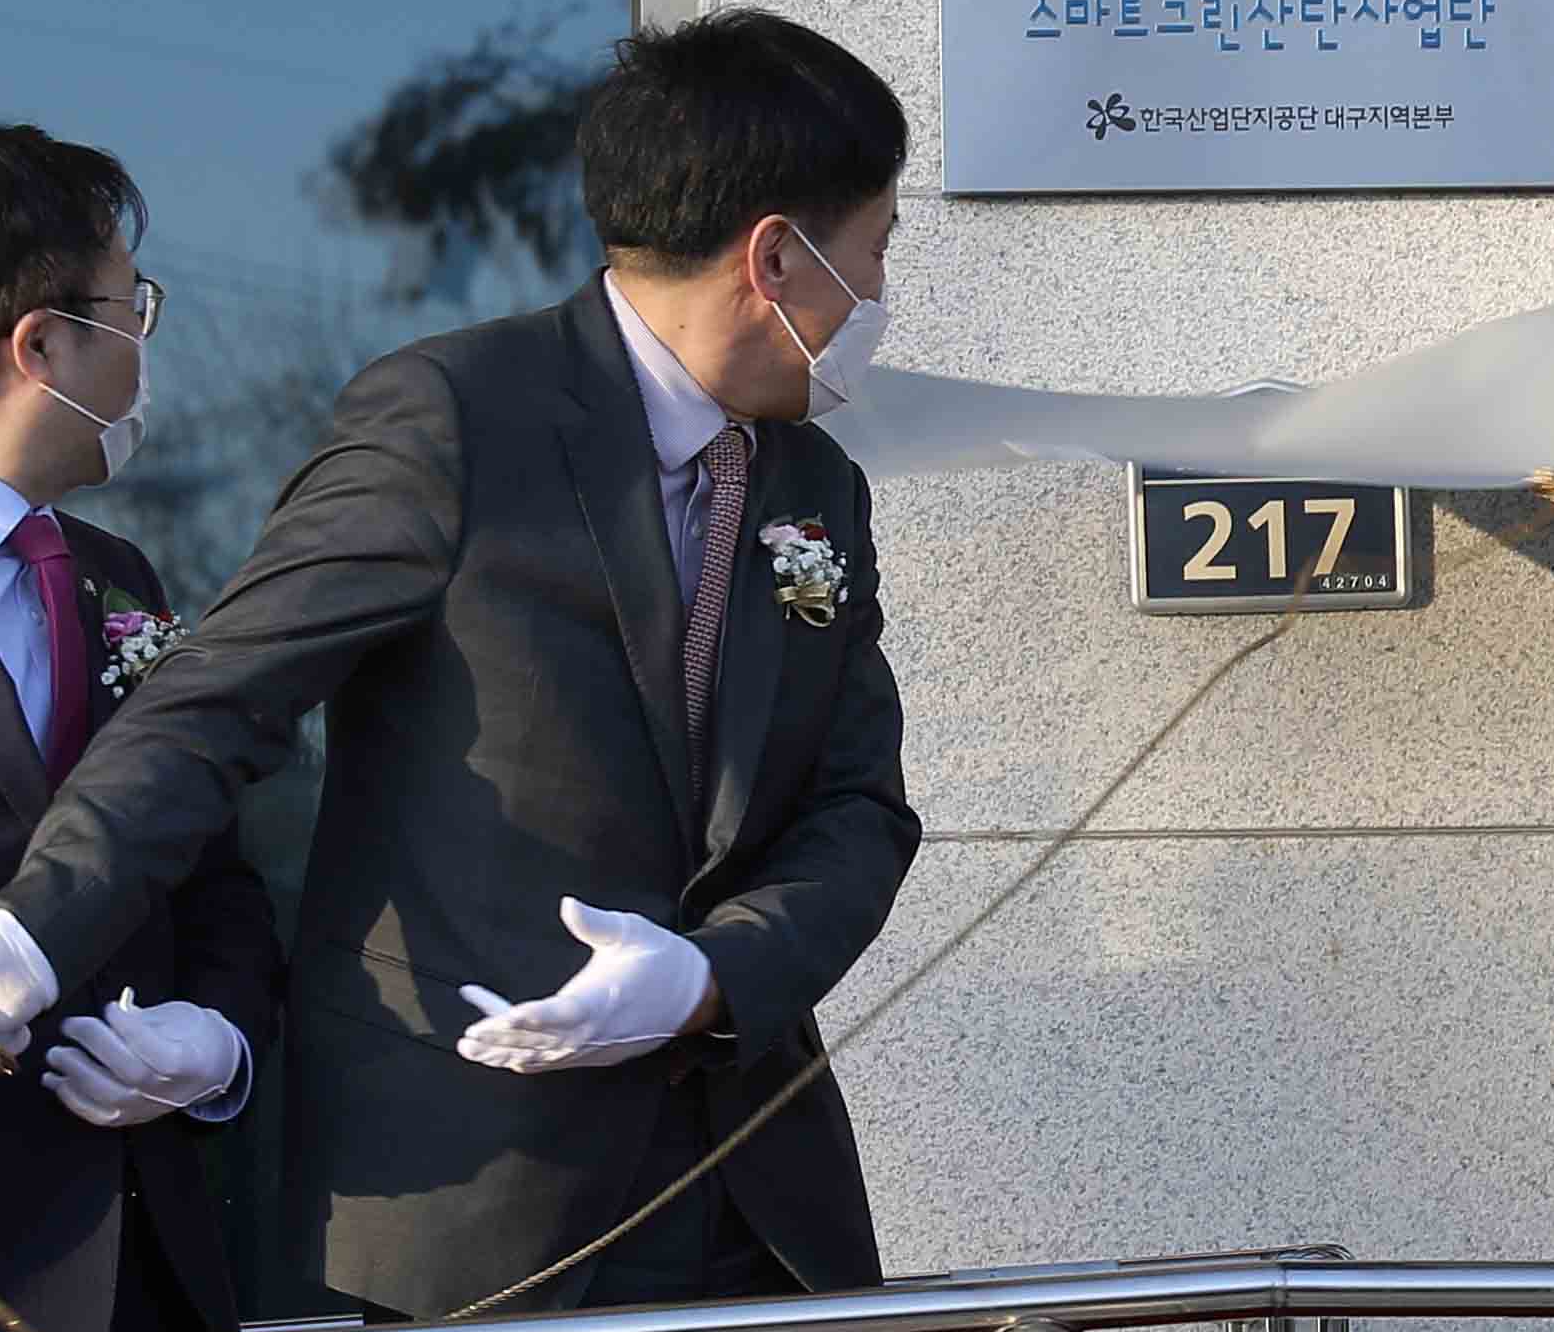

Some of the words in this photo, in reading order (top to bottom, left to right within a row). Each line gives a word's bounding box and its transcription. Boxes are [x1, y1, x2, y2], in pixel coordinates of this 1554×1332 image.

[1140, 105, 1319, 132] 한국산업단지공단
[1324, 103, 1456, 131] 대구지역본부
[1182, 498, 1357, 581] 217
[1321, 574, 1389, 589] 42704
